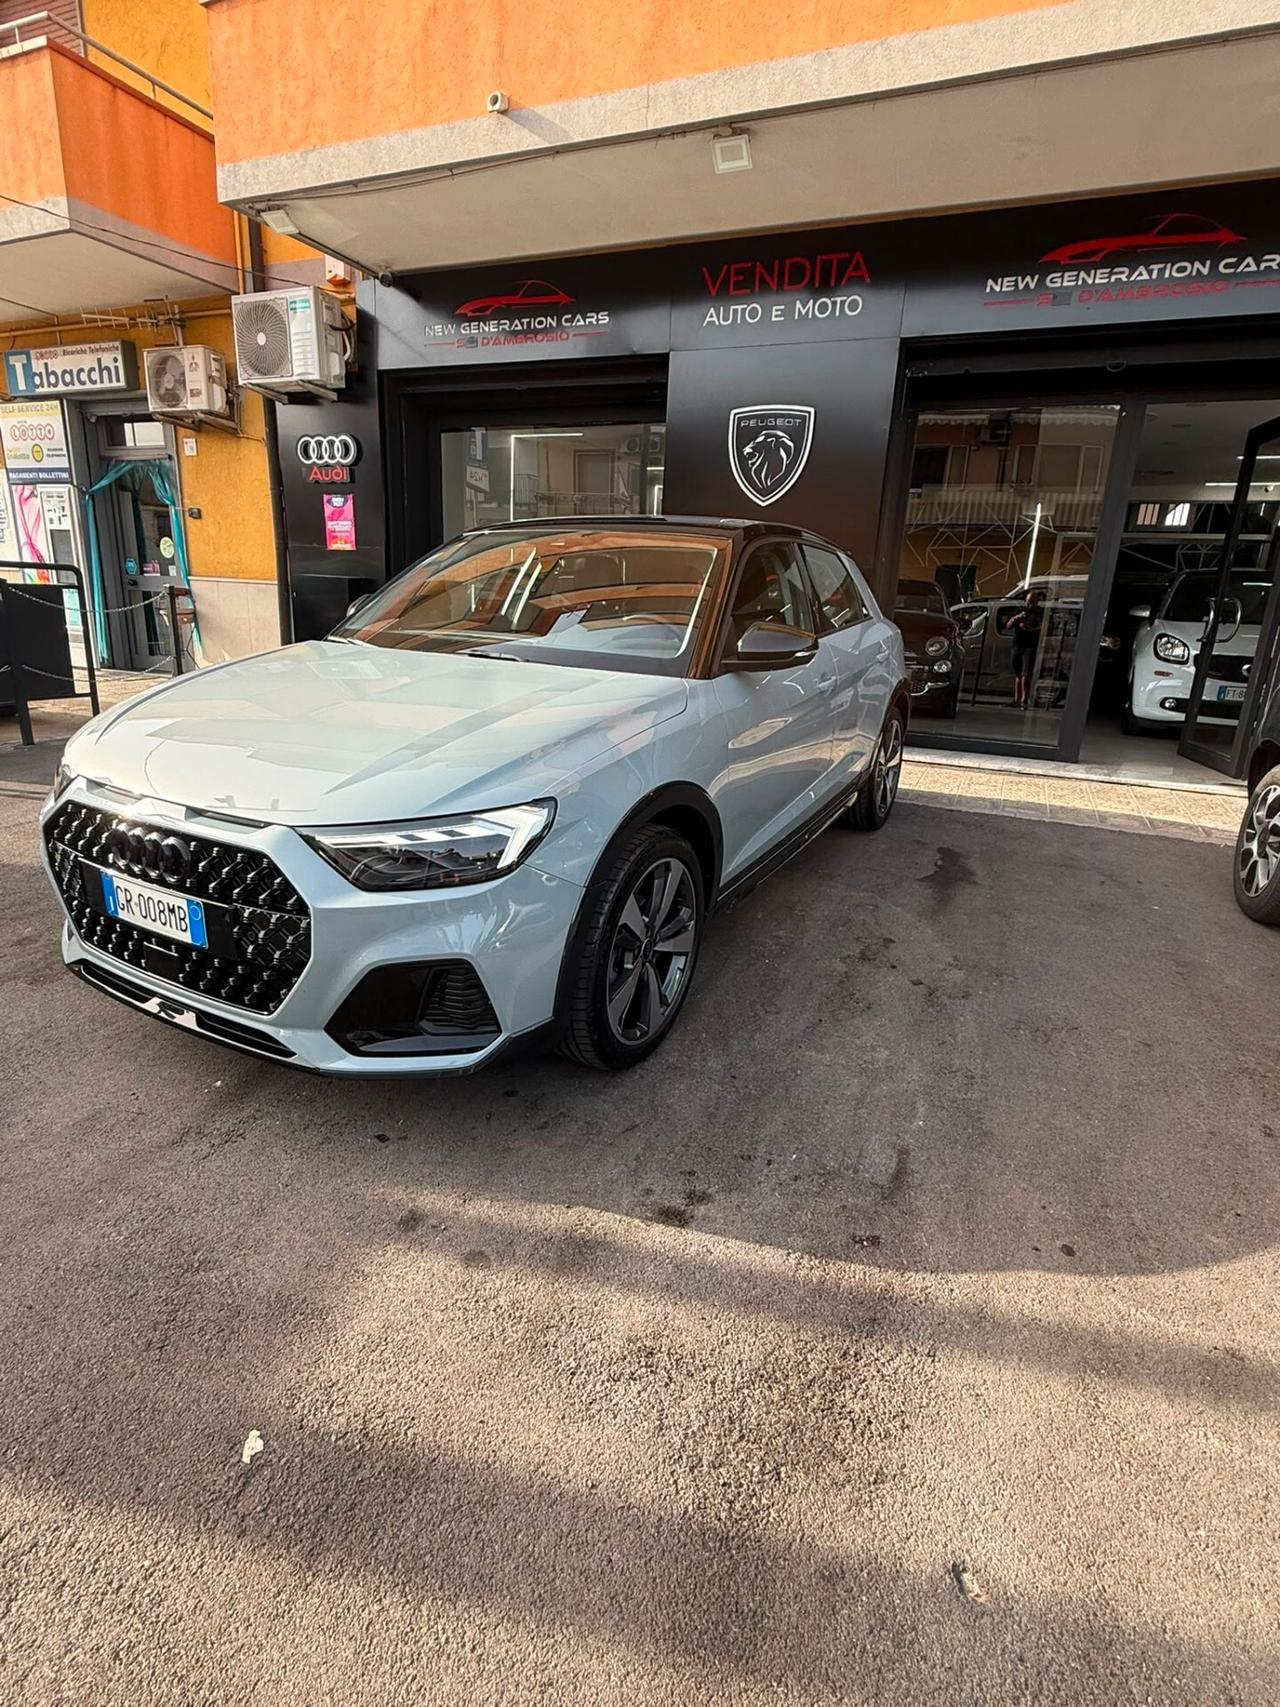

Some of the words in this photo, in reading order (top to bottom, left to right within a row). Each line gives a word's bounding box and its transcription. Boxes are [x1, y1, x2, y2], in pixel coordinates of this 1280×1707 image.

[702, 252, 871, 297] VENDITA
[985, 273, 1040, 293] NEW
[1045, 259, 1211, 288] GENERATION
[1218, 253, 1280, 274] CAR
[703, 303, 762, 327] AUTO
[771, 305, 785, 321] E
[794, 295, 863, 320] MOTO
[424, 323, 456, 336] NEW
[460, 315, 557, 334] GENERATION
[561, 311, 610, 327] CARS
[481, 331, 571, 347] D'AMBROSIO
[88, 344, 120, 355] Telefoniche
[8, 355, 121, 391] Tabacchi
[11, 425, 54, 440] LOTTO
[740, 417, 802, 428] PEUGEOT
[309, 465, 348, 481] Audi
